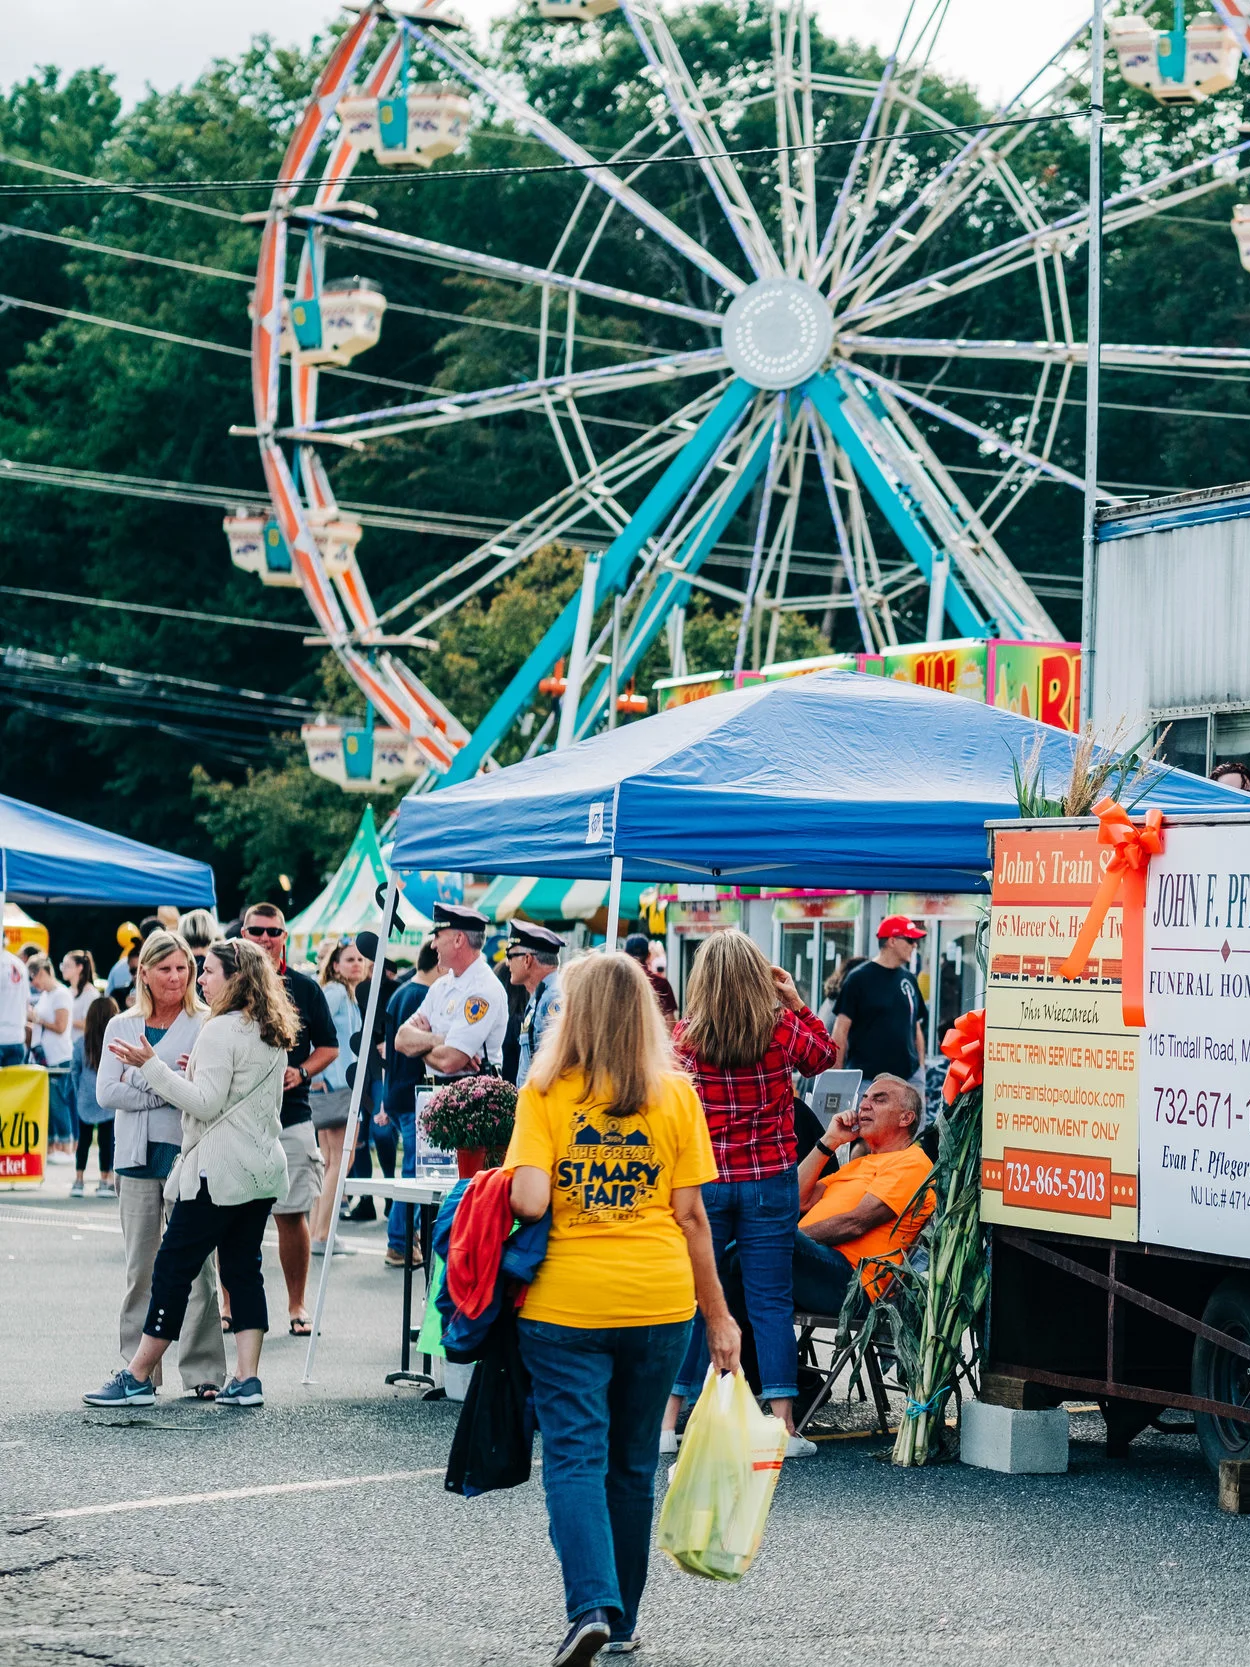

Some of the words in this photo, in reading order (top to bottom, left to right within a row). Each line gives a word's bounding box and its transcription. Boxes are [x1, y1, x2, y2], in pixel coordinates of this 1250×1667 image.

[999, 850, 1046, 884] John's
[1052, 850, 1092, 884] Train
[1153, 873, 1200, 928] JOHN
[1205, 873, 1219, 928] F.
[997, 914, 1008, 937] 65
[1010, 914, 1046, 938] Mercer
[1149, 970, 1213, 997] FUNERAL
[1018, 998, 1041, 1029] John
[988, 1042, 1021, 1063] ELECTRIC
[1024, 1045, 1046, 1066] TRAIN
[1049, 1046, 1082, 1068] SERVICE
[1084, 1048, 1103, 1070] AND
[1106, 1049, 1134, 1071] SALES
[1148, 1034, 1165, 1057] 115
[1168, 1034, 1200, 1059] Tindall
[1205, 1037, 1237, 1066] Road,
[994, 1080, 1125, 1108] johnstrainstop@outlook.com
[996, 1112, 1009, 1130] BY
[1012, 1114, 1088, 1138] APPOINTMENT
[1092, 1122, 1120, 1141] ONLY
[569, 1145, 597, 1159] THE
[602, 1145, 654, 1160] GREAT
[1161, 1145, 1187, 1171] Evan
[1191, 1148, 1203, 1173] F.
[588, 1160, 660, 1186] MARY
[1006, 1162, 1105, 1202] 732-865-5203
[584, 1184, 636, 1209] FAIR
[1190, 1185, 1203, 1205] NJ
[1205, 1187, 1227, 1209] Lic.#
